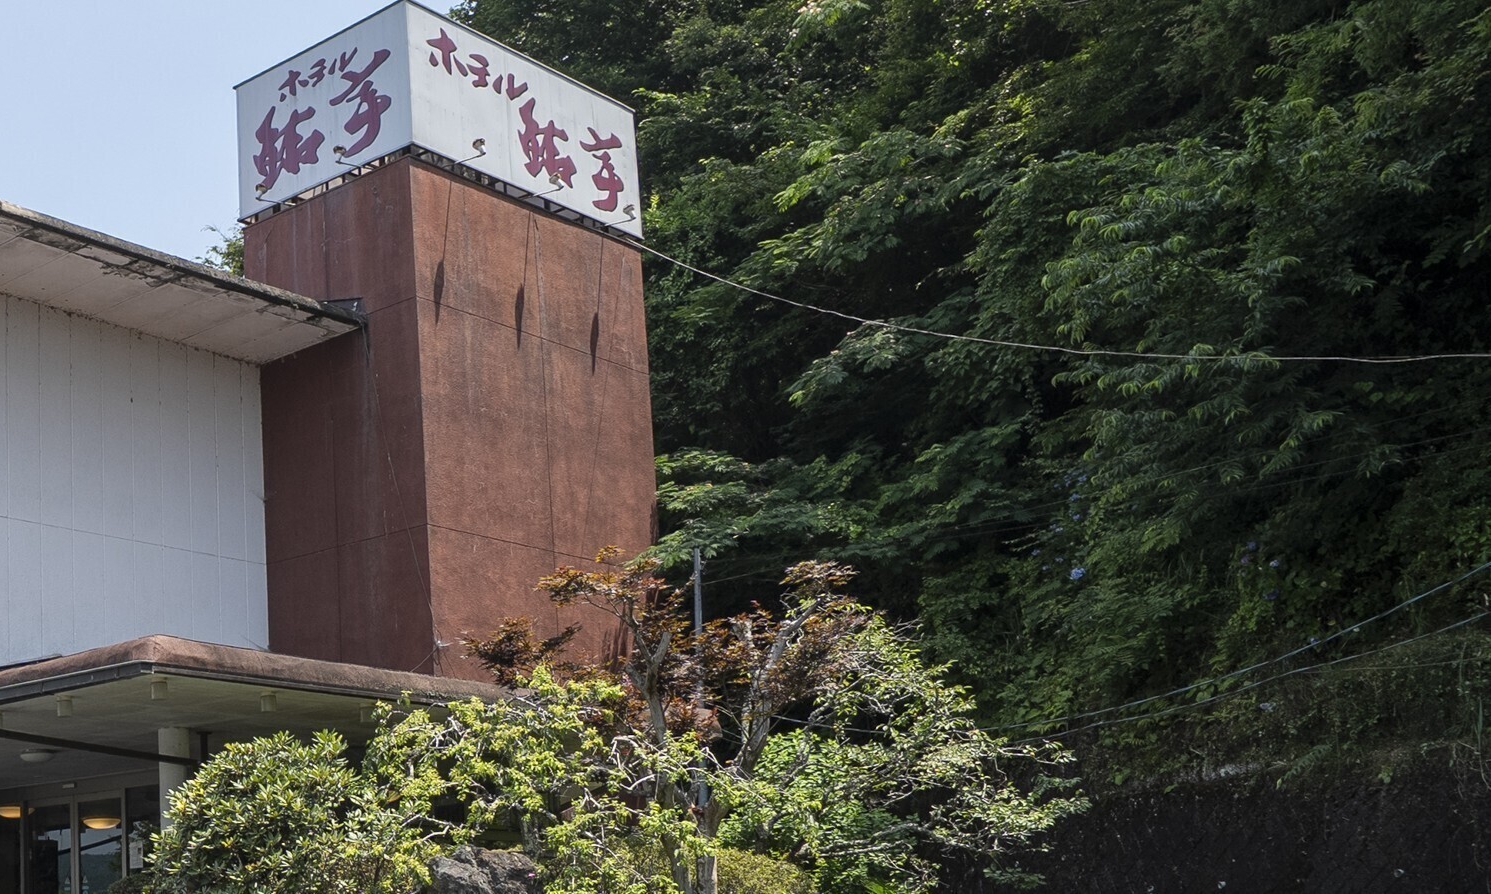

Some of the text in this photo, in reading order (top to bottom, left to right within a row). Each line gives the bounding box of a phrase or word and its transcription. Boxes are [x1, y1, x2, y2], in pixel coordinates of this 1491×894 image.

[278, 47, 358, 102] ホテル
[426, 27, 528, 101] ホテル
